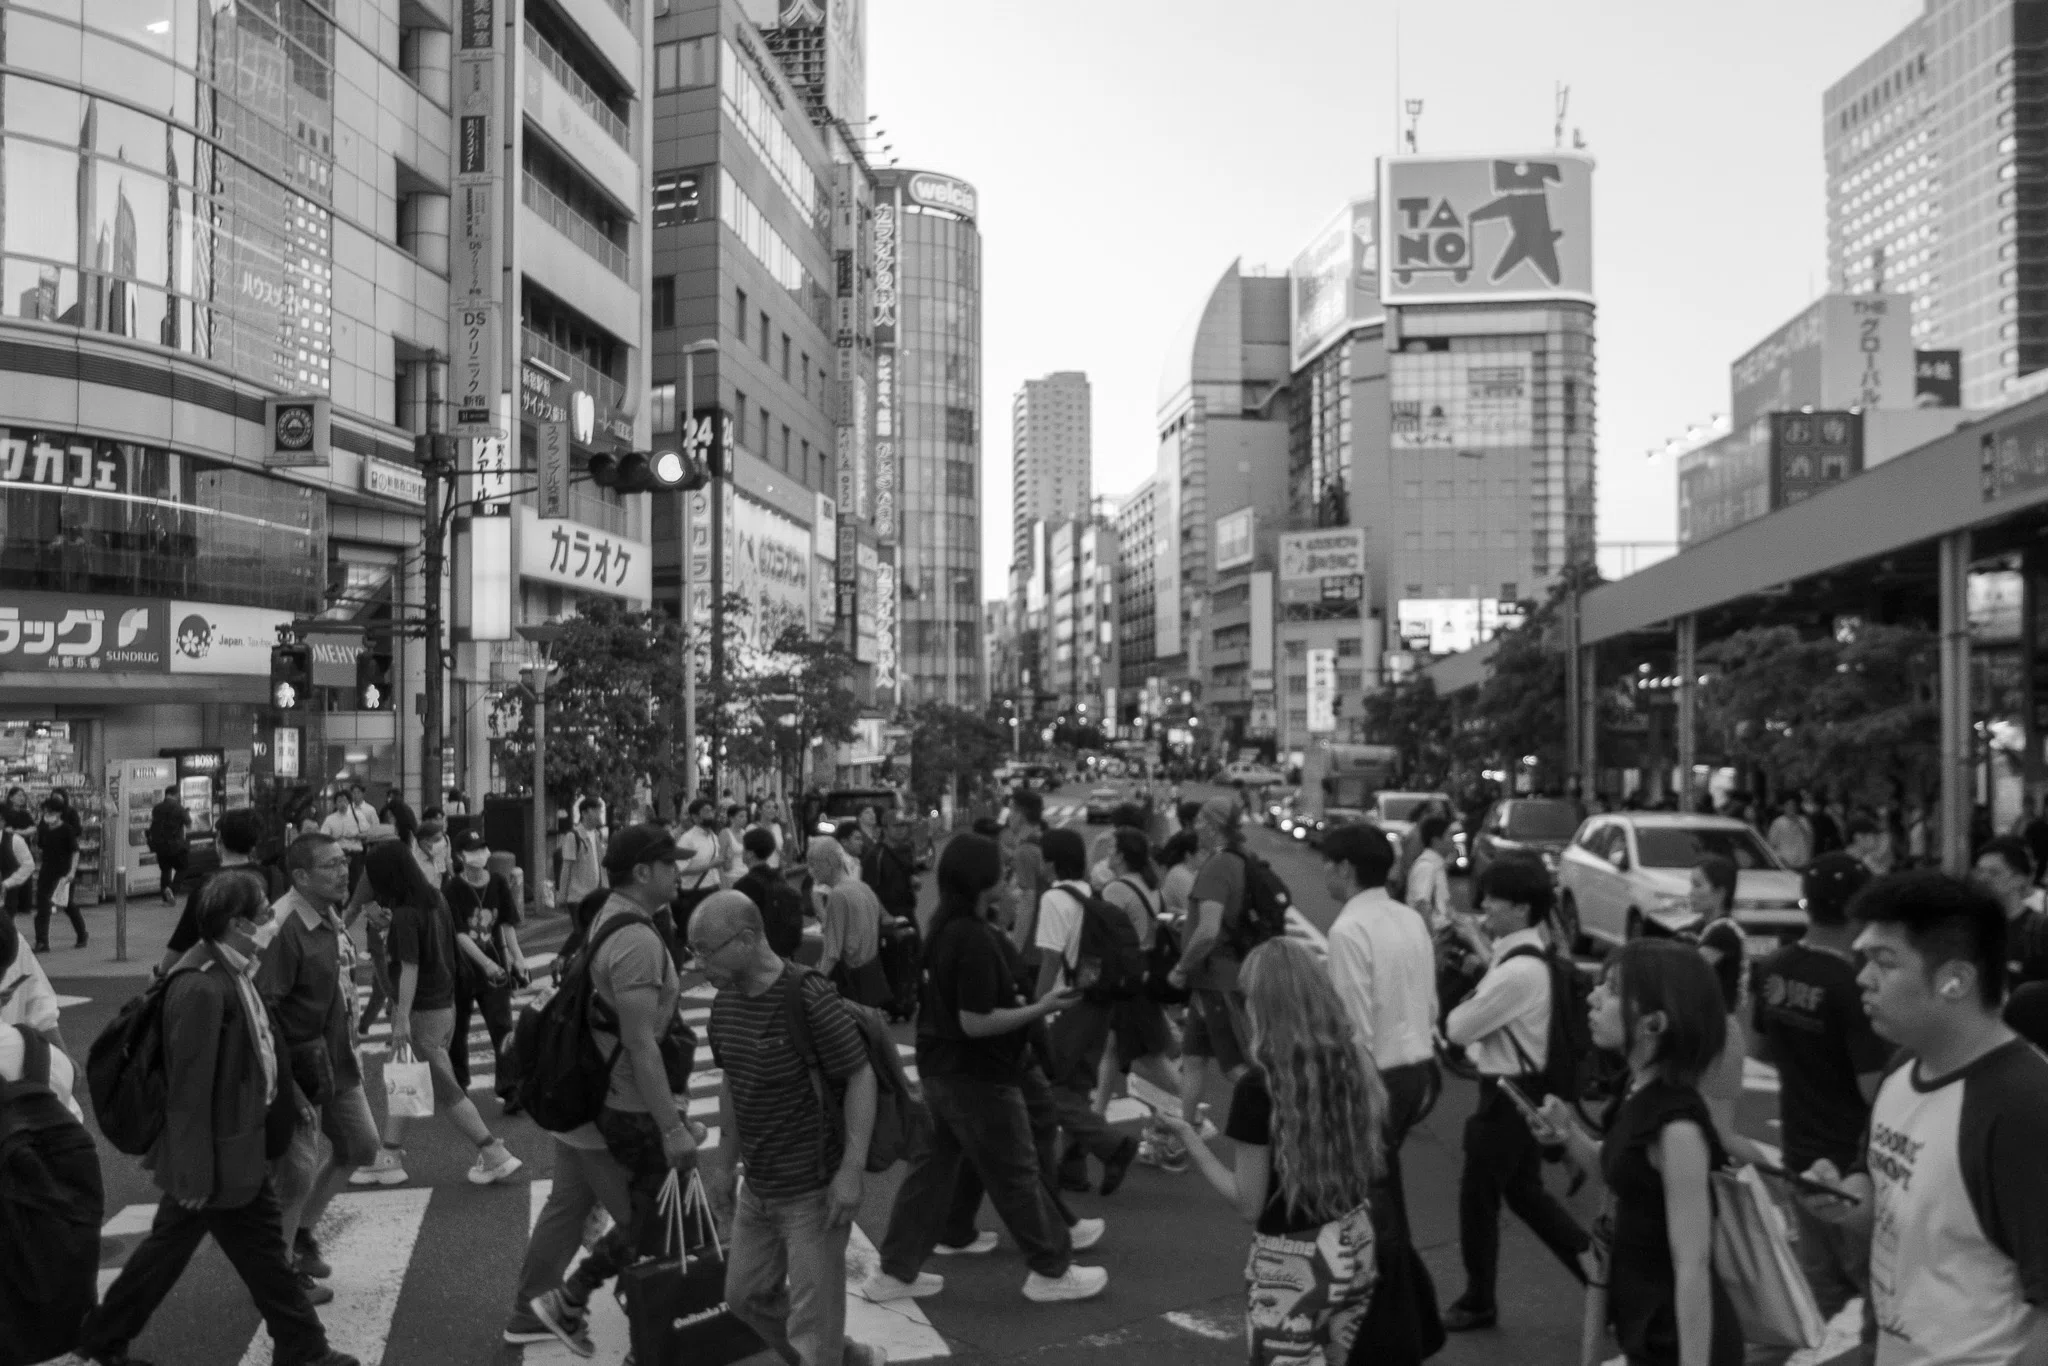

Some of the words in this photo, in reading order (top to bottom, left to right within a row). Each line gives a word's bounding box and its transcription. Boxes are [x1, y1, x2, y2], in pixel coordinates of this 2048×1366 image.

[1398, 197, 1462, 229] TA
[1398, 232, 1467, 265] NO
[464, 312, 487, 326] DS
[549, 524, 631, 587] カラオケ
[106, 650, 160, 663] SUNDRUG
[132, 766, 158, 780] KIRIN
